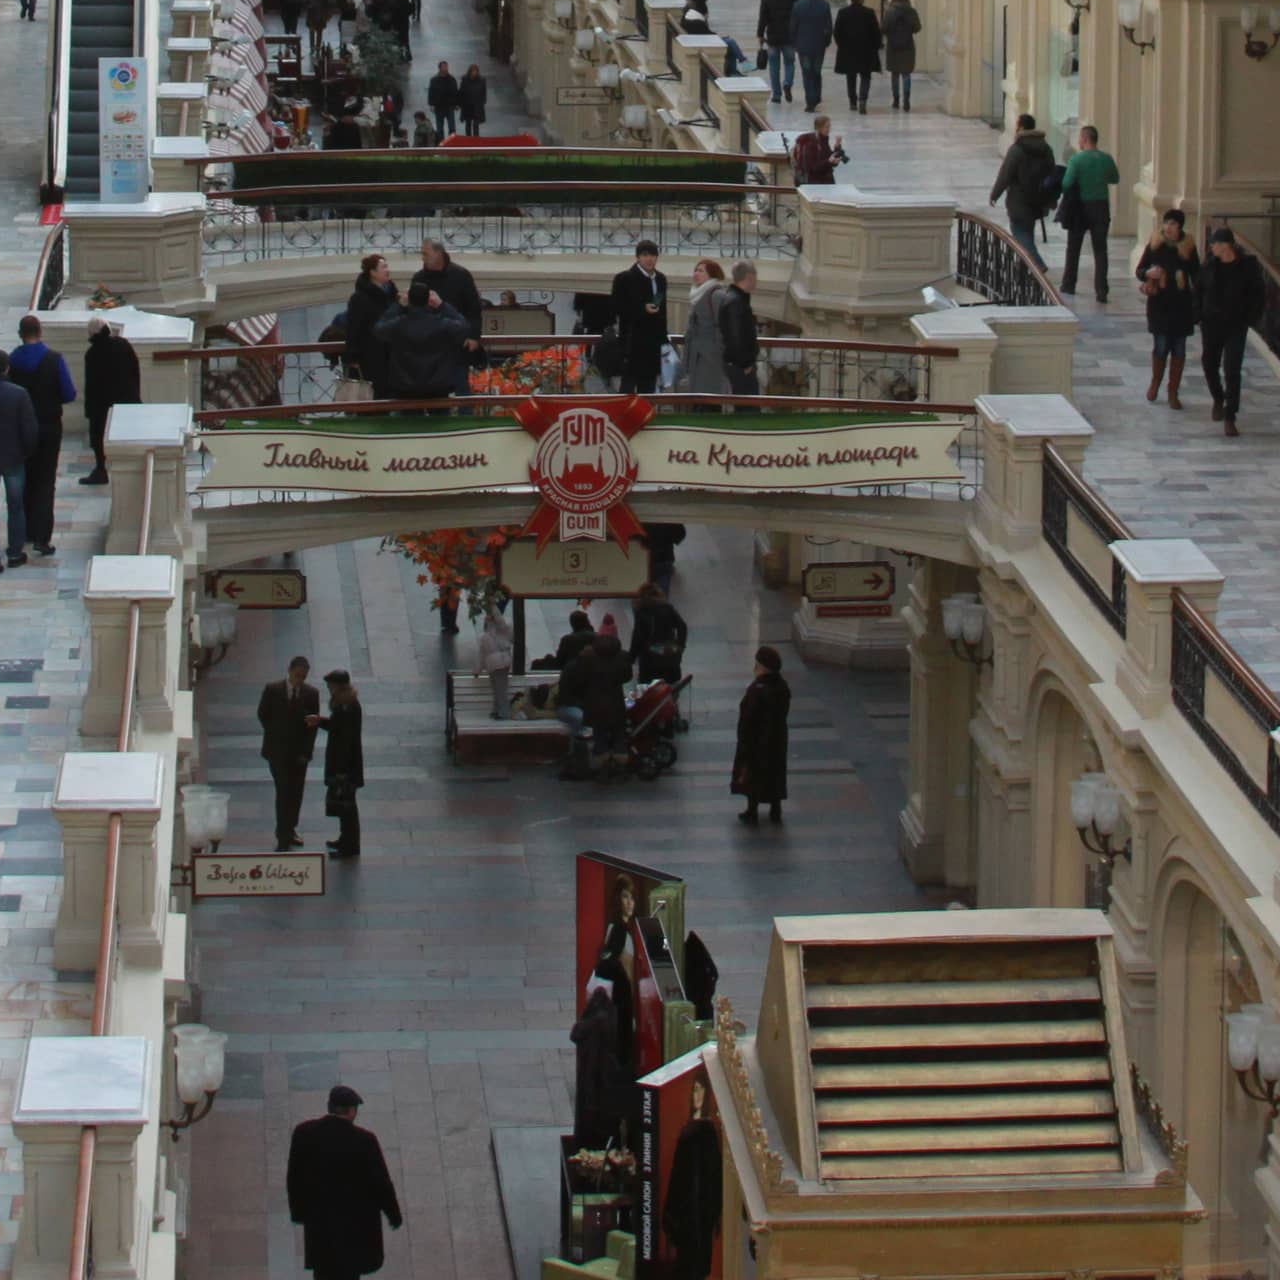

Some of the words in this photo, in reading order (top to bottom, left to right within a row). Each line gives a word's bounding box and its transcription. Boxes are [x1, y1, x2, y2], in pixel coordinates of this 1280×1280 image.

[562, 414, 605, 446] ГУМ
[263, 443, 369, 472] Главный
[382, 452, 489, 472] магазин
[667, 448, 699, 464] на
[706, 443, 811, 474] Красной
[816, 444, 919, 467] площади
[542, 483, 580, 510] КРАСНАЯ
[566, 515, 599, 529] GUM
[570, 553, 580, 568] 3
